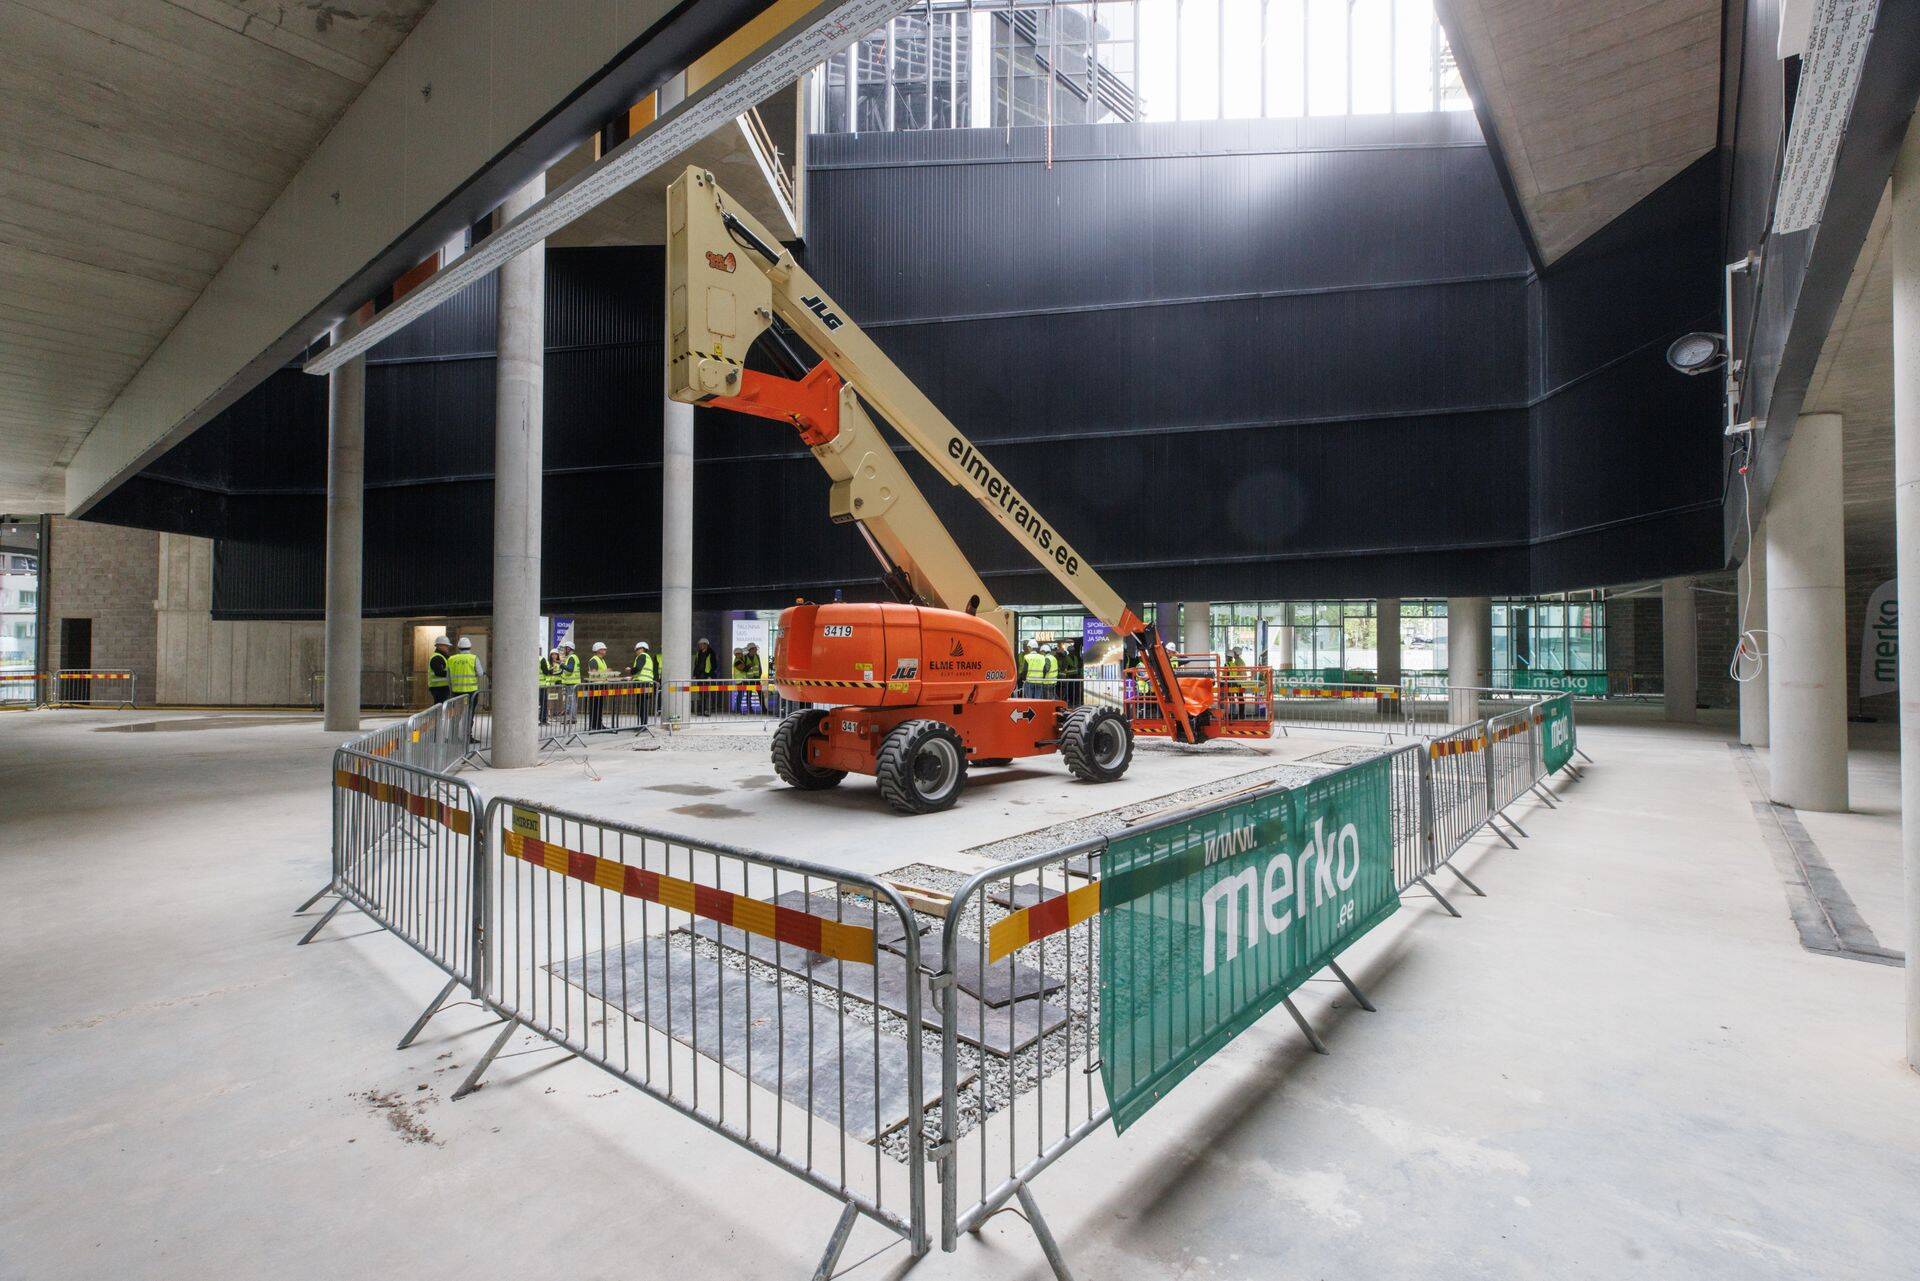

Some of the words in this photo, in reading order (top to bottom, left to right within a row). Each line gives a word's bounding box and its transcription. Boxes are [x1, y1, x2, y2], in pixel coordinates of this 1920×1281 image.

[800, 295, 844, 331] JLG
[947, 436, 1079, 576] elmetrans.ee
[824, 626, 853, 637] 3419
[891, 667, 917, 680] JLG
[929, 661, 953, 670] ELME
[956, 661, 982, 670] TRANS
[1533, 675, 1588, 688] merko
[842, 720, 860, 732] 341
[1204, 822, 1258, 867] www.
[1202, 815, 1361, 977] merko
[1336, 897, 1355, 929] .ee
